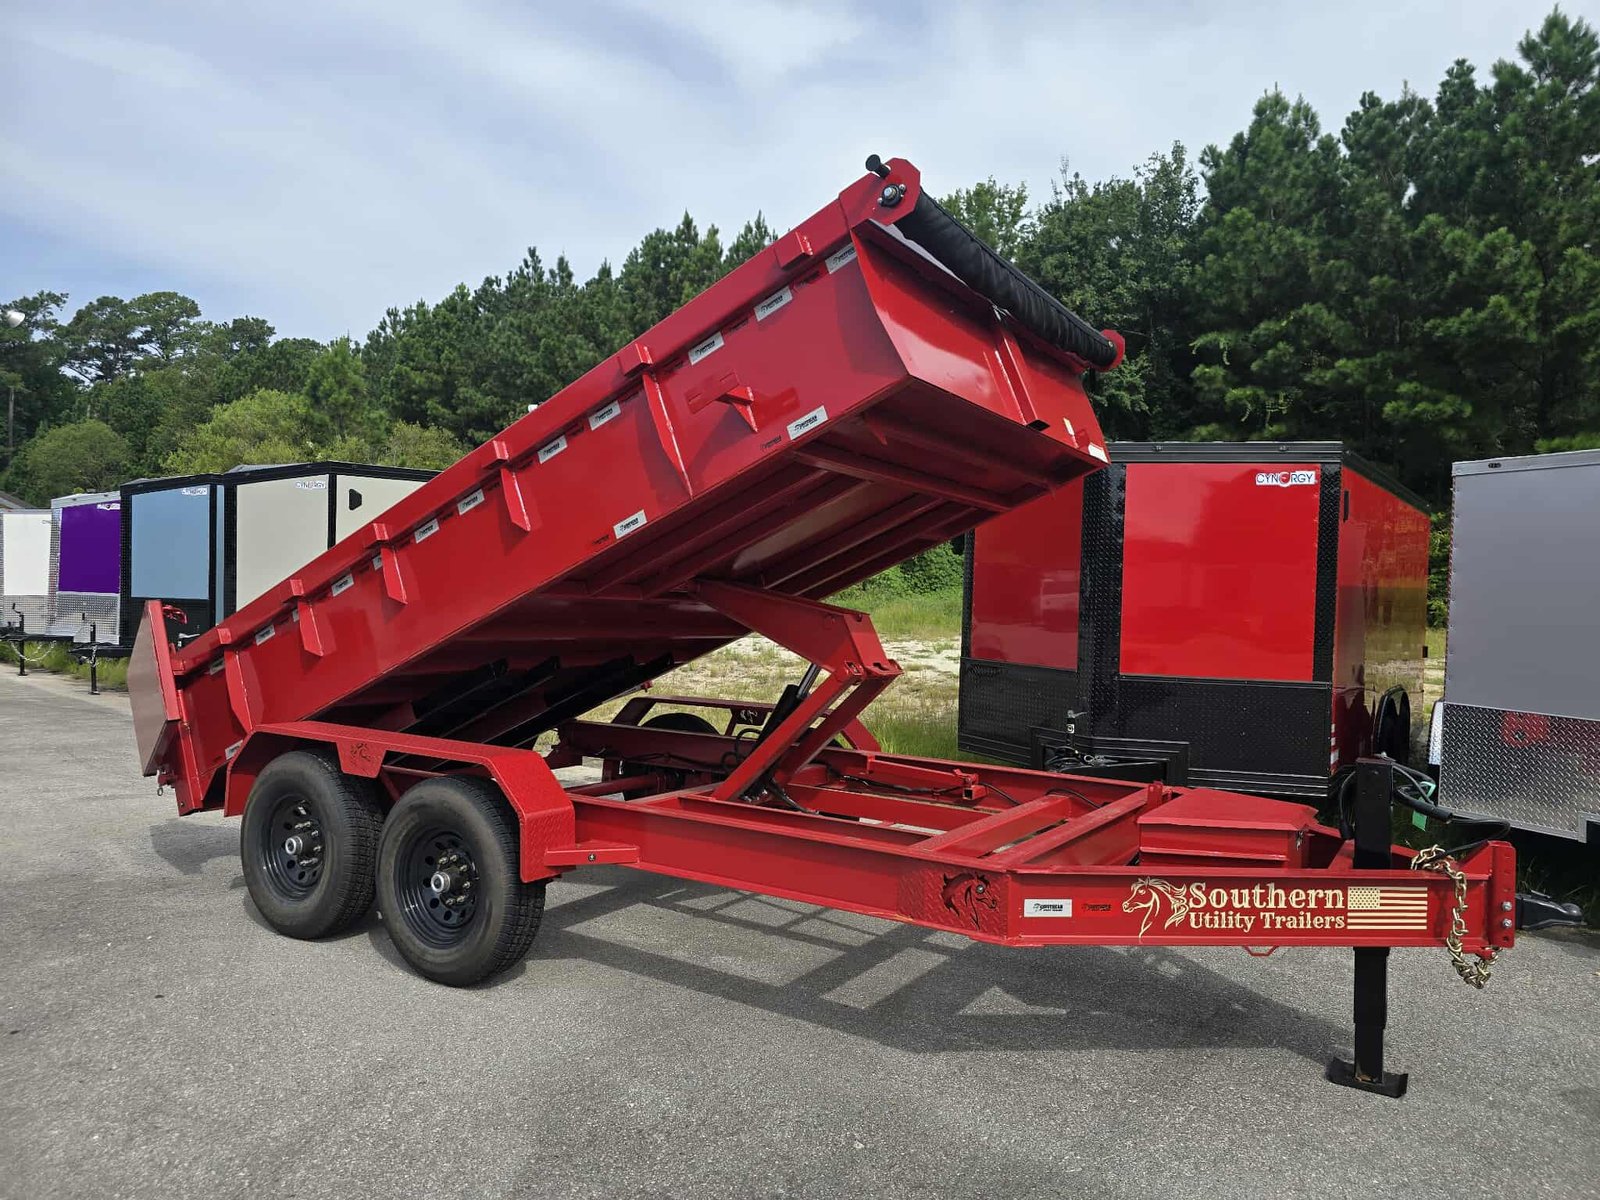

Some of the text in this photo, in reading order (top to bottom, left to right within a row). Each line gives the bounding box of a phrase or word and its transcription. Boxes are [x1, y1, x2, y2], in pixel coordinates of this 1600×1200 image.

[1188, 882, 1345, 909] Southern
[1189, 912, 1345, 932] Utility Trailers
